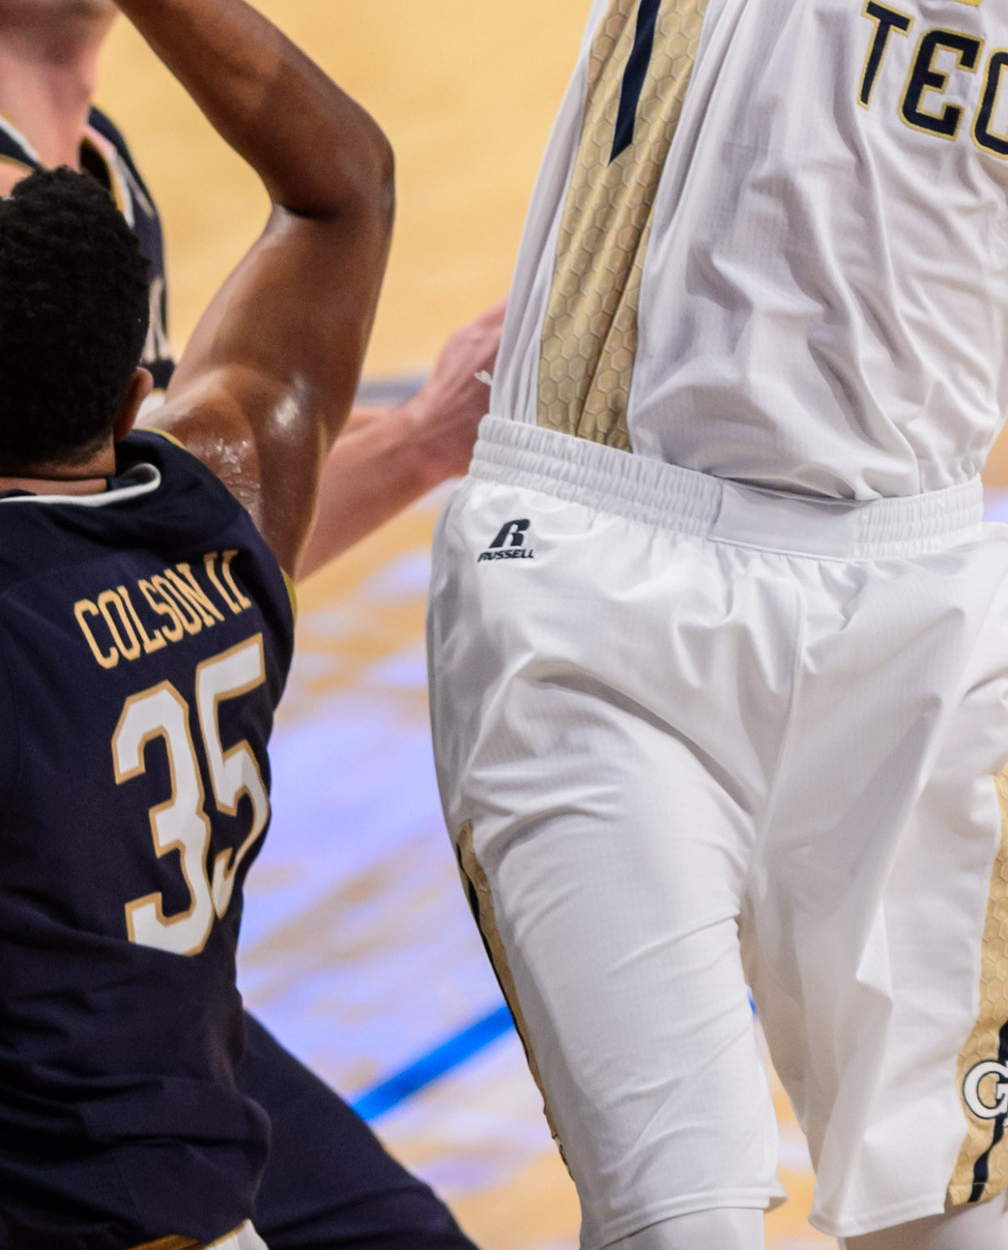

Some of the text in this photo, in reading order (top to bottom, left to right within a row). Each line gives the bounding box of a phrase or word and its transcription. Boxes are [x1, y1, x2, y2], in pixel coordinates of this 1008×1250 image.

[73, 549, 252, 670] COLSON II
[477, 549, 534, 563] RUSSELL
[111, 632, 271, 957] 35
